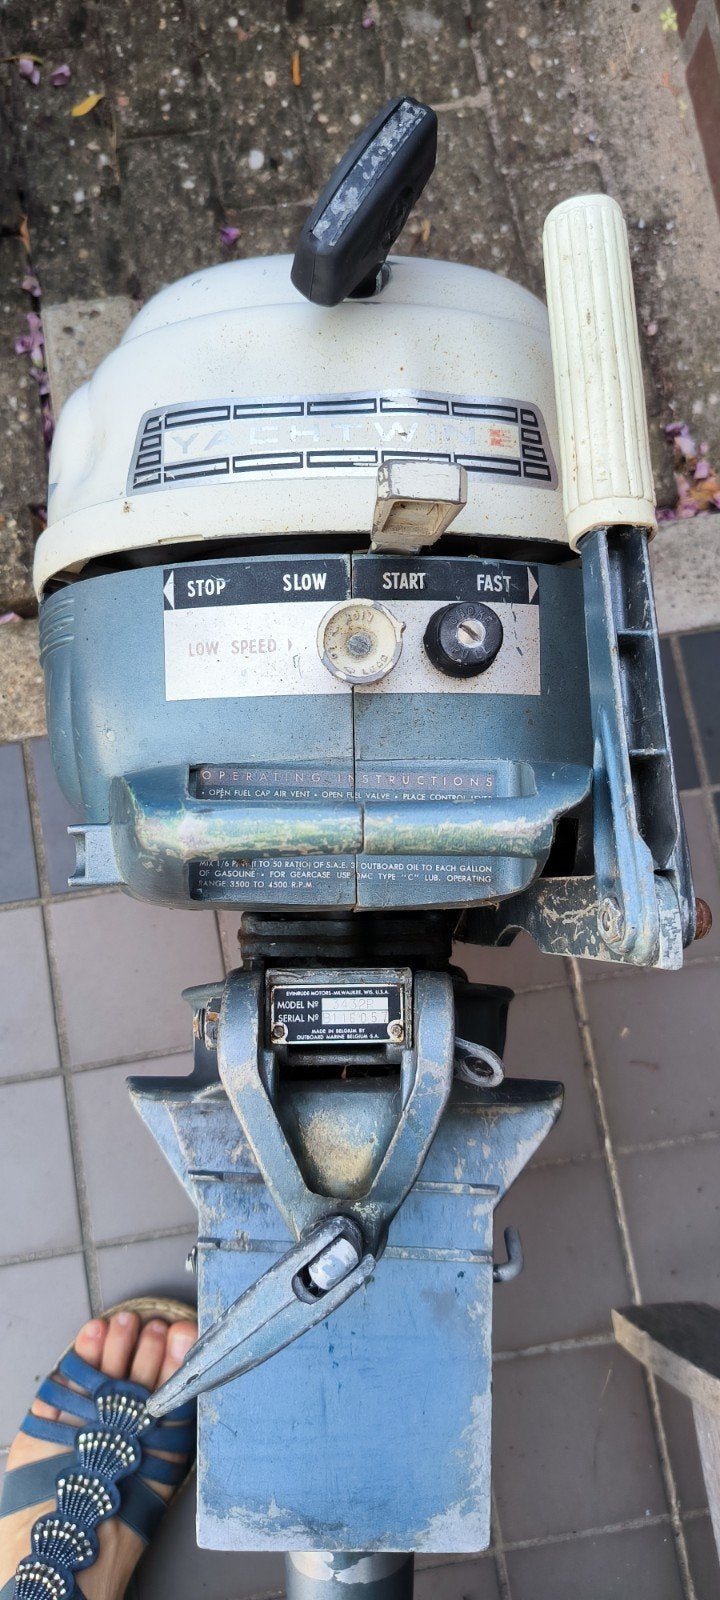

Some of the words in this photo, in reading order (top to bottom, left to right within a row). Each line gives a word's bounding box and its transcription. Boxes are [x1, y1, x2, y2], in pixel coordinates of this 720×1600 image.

[187, 578, 227, 598] STOP
[282, 572, 327, 592] SLOW
[382, 571, 427, 591] START
[476, 573, 512, 593] FAST
[188, 640, 220, 658] LOW
[231, 638, 277, 655] SPEED
[201, 770, 322, 783] OPERATING
[337, 771, 493, 788] INSTRUCTIONS
[208, 789, 231, 797] OPEN
[233, 789, 252, 797] FUEL
[273, 790, 287, 798] AIR
[290, 790, 311, 798] VENT
[321, 790, 343, 798] OPEN
[365, 792, 391, 800] VALVE
[402, 793, 426, 801] PLACE
[360, 862, 404, 870] OUTBOARD
[406, 863, 419, 871] OIL
[421, 863, 433, 871] TO
[435, 864, 457, 872] EACH
[459, 864, 492, 873] GALLON
[214, 870, 256, 878] GASOLINE
[289, 871, 331, 879] GEARCASE
[336, 871, 351, 879] USE
[424, 874, 441, 882] LUB.
[446, 874, 492, 883] OPERATING
[198, 879, 226, 888] RANGE
[229, 880, 250, 888] 3500
[253, 880, 265, 888] TO
[277, 1000, 304, 1010] MODEL
[277, 1013, 305, 1023] SERIAL
